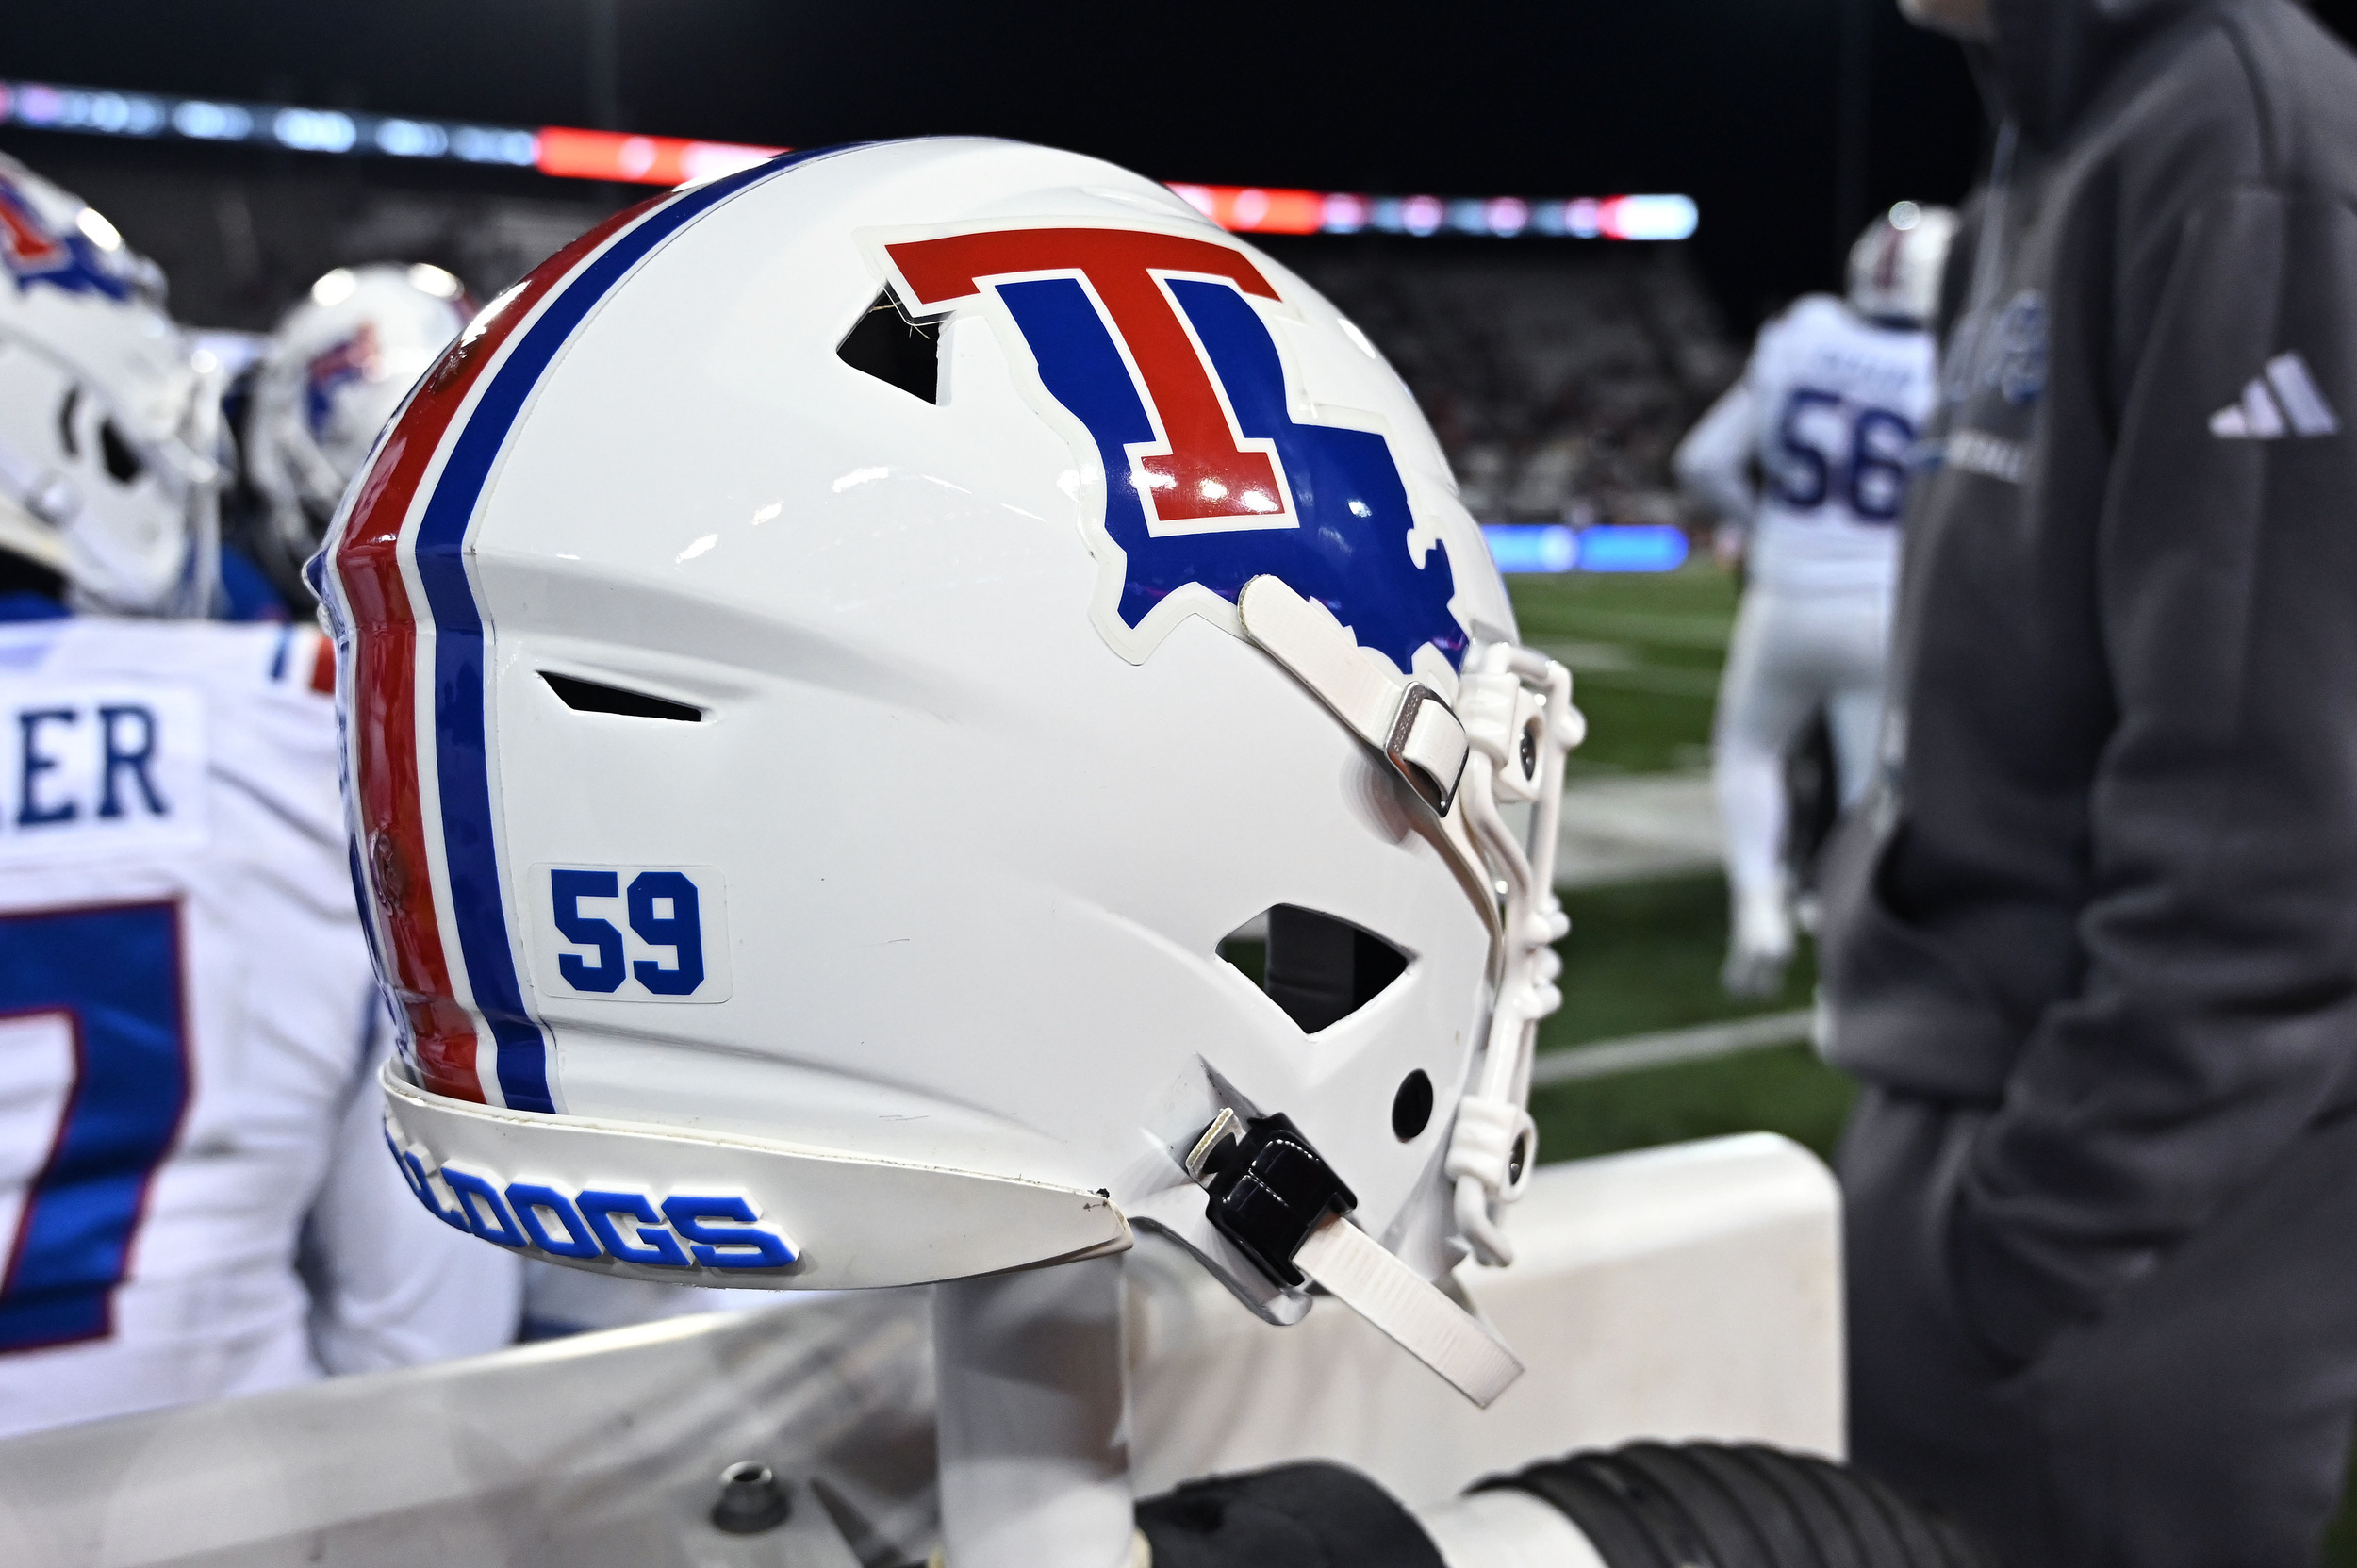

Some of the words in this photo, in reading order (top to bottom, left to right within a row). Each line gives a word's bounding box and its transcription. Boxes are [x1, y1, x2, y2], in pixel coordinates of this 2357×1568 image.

[886, 227, 1286, 523] T
[1780, 386, 1915, 521] 56
[0, 704, 172, 827] ER
[551, 868, 705, 996] 59
[0, 895, 194, 1355] 7
[384, 1122, 799, 1269] LDOGS
